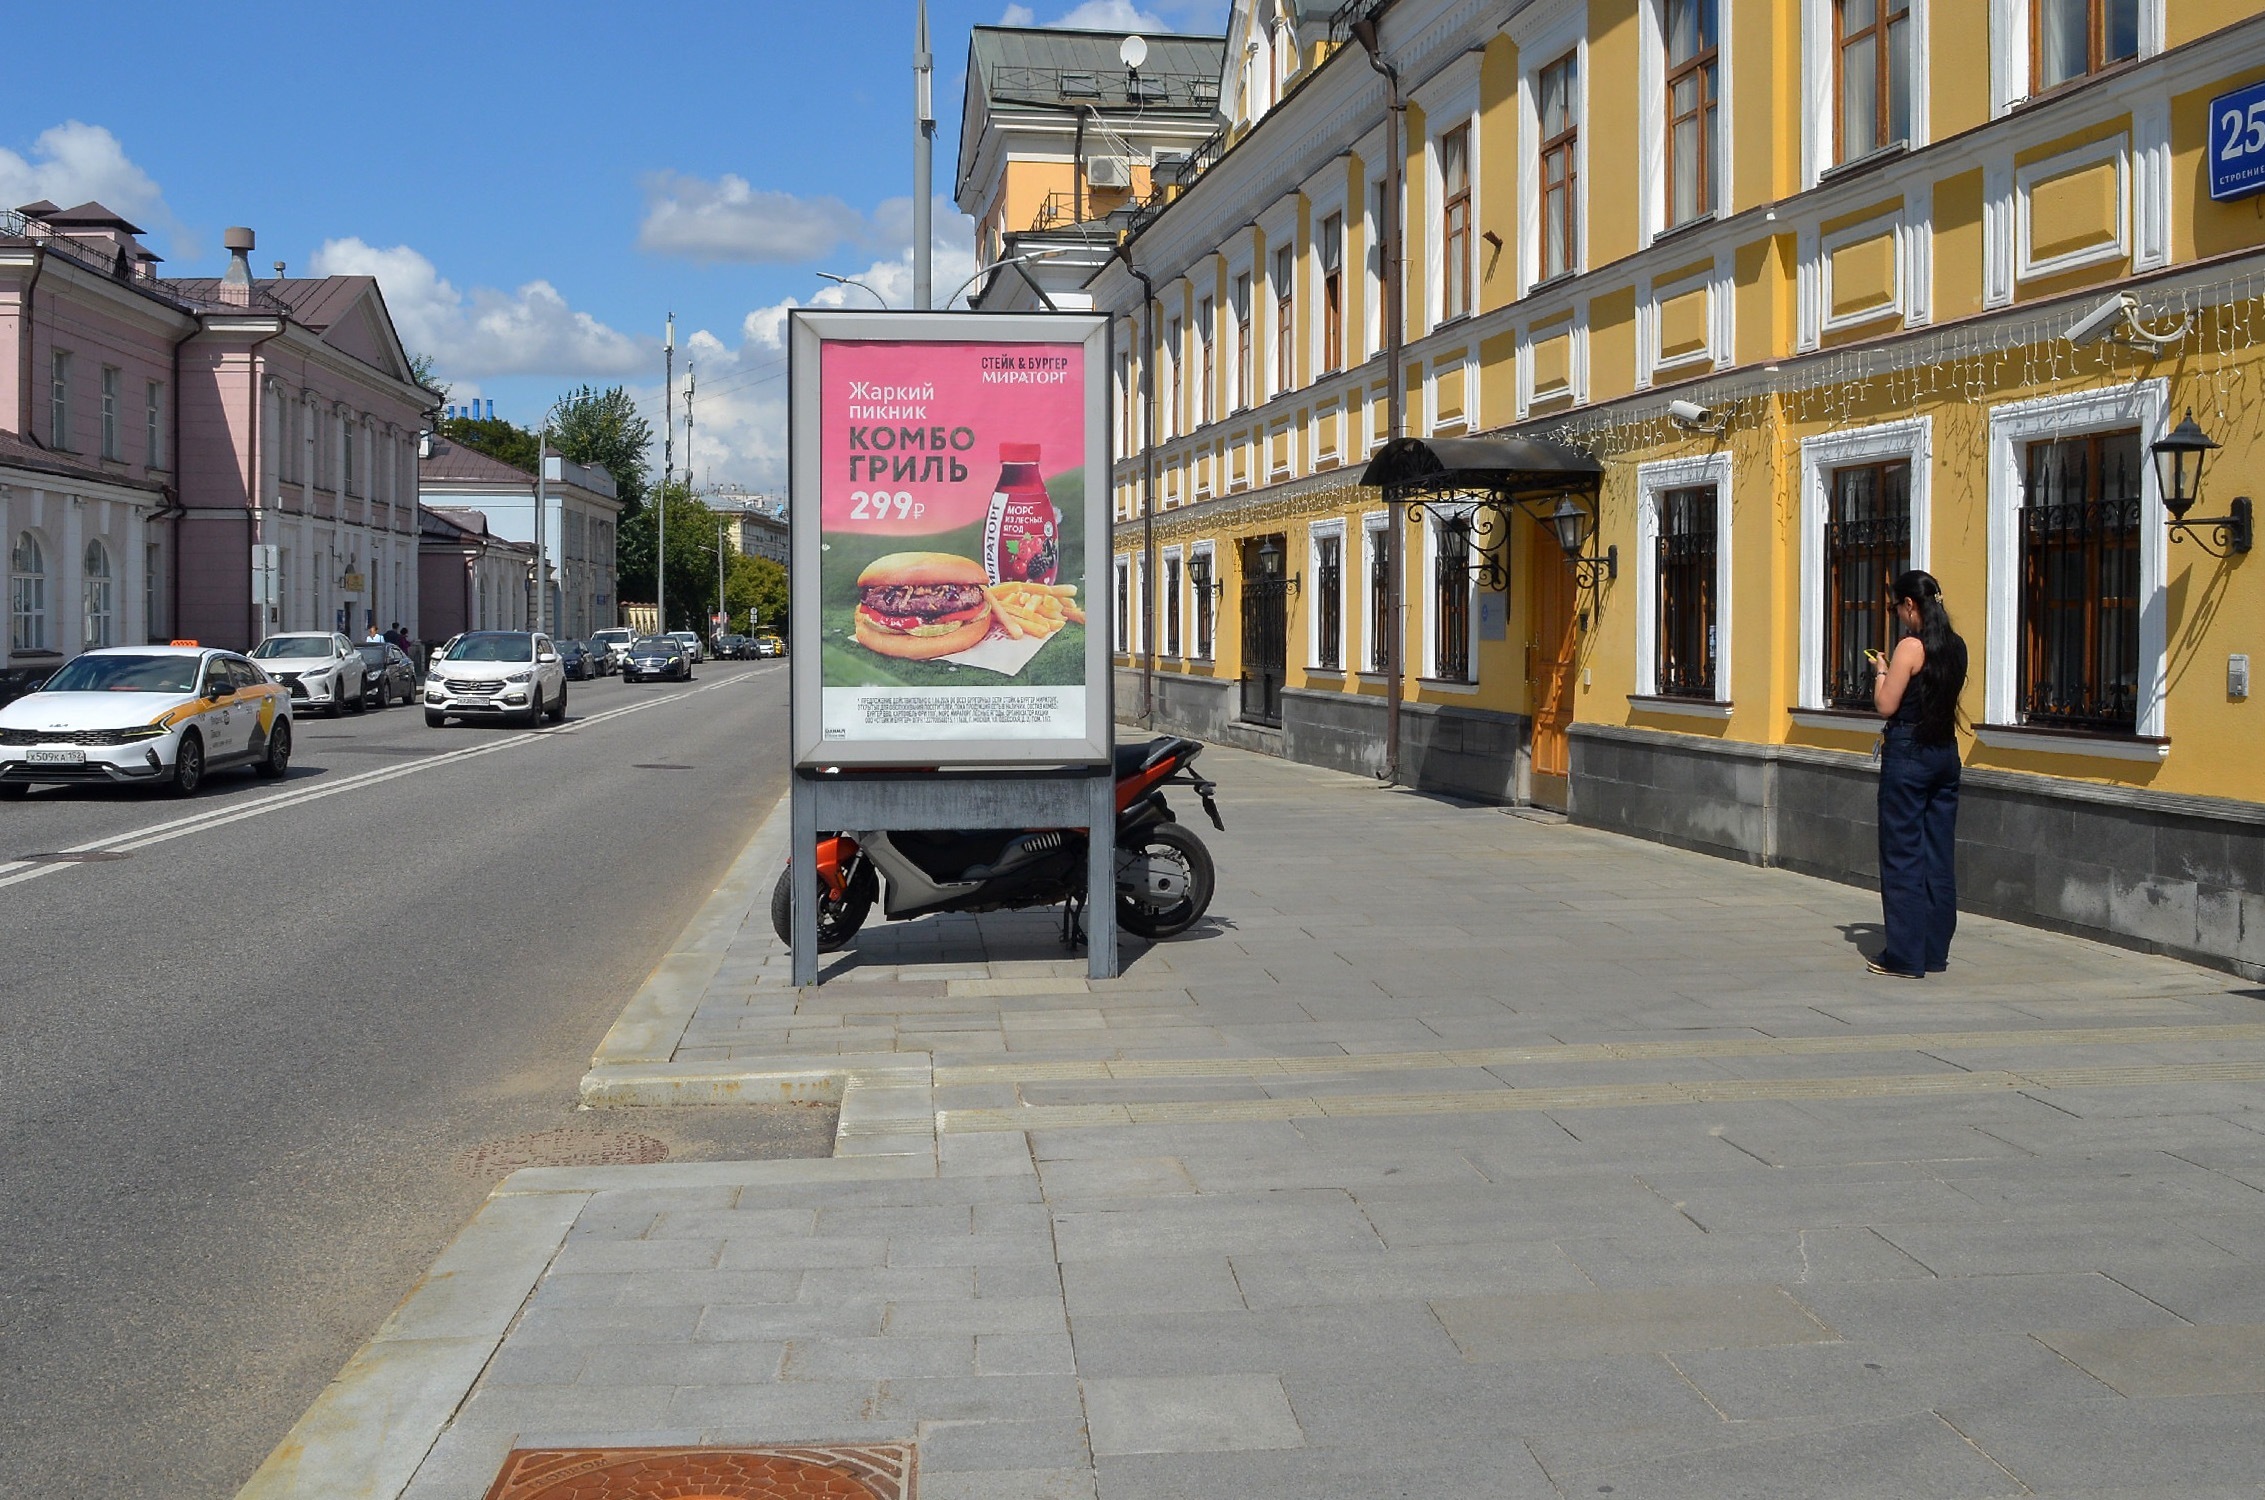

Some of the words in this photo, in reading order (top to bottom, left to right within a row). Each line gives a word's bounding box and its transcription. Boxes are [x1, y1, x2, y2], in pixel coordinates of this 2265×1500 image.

[2220, 100, 2265, 161] 25
[2219, 164, 2265, 185] СТРОЕНИЕ
[981, 354, 1015, 370] СТЕЙК
[1018, 357, 1026, 370] &
[1028, 357, 1068, 370] БУРГЕР
[982, 371, 1068, 384] МИРАТОРГ
[848, 381, 935, 405] Жаркий
[849, 405, 927, 420] пикник
[849, 426, 976, 451] КОМБО
[849, 455, 968, 483] ГРИЛЬ
[1007, 505, 1034, 515] МОРС
[1015, 516, 1043, 524] ЛЕСНЫХ
[1003, 524, 1024, 534] ЯГОД
